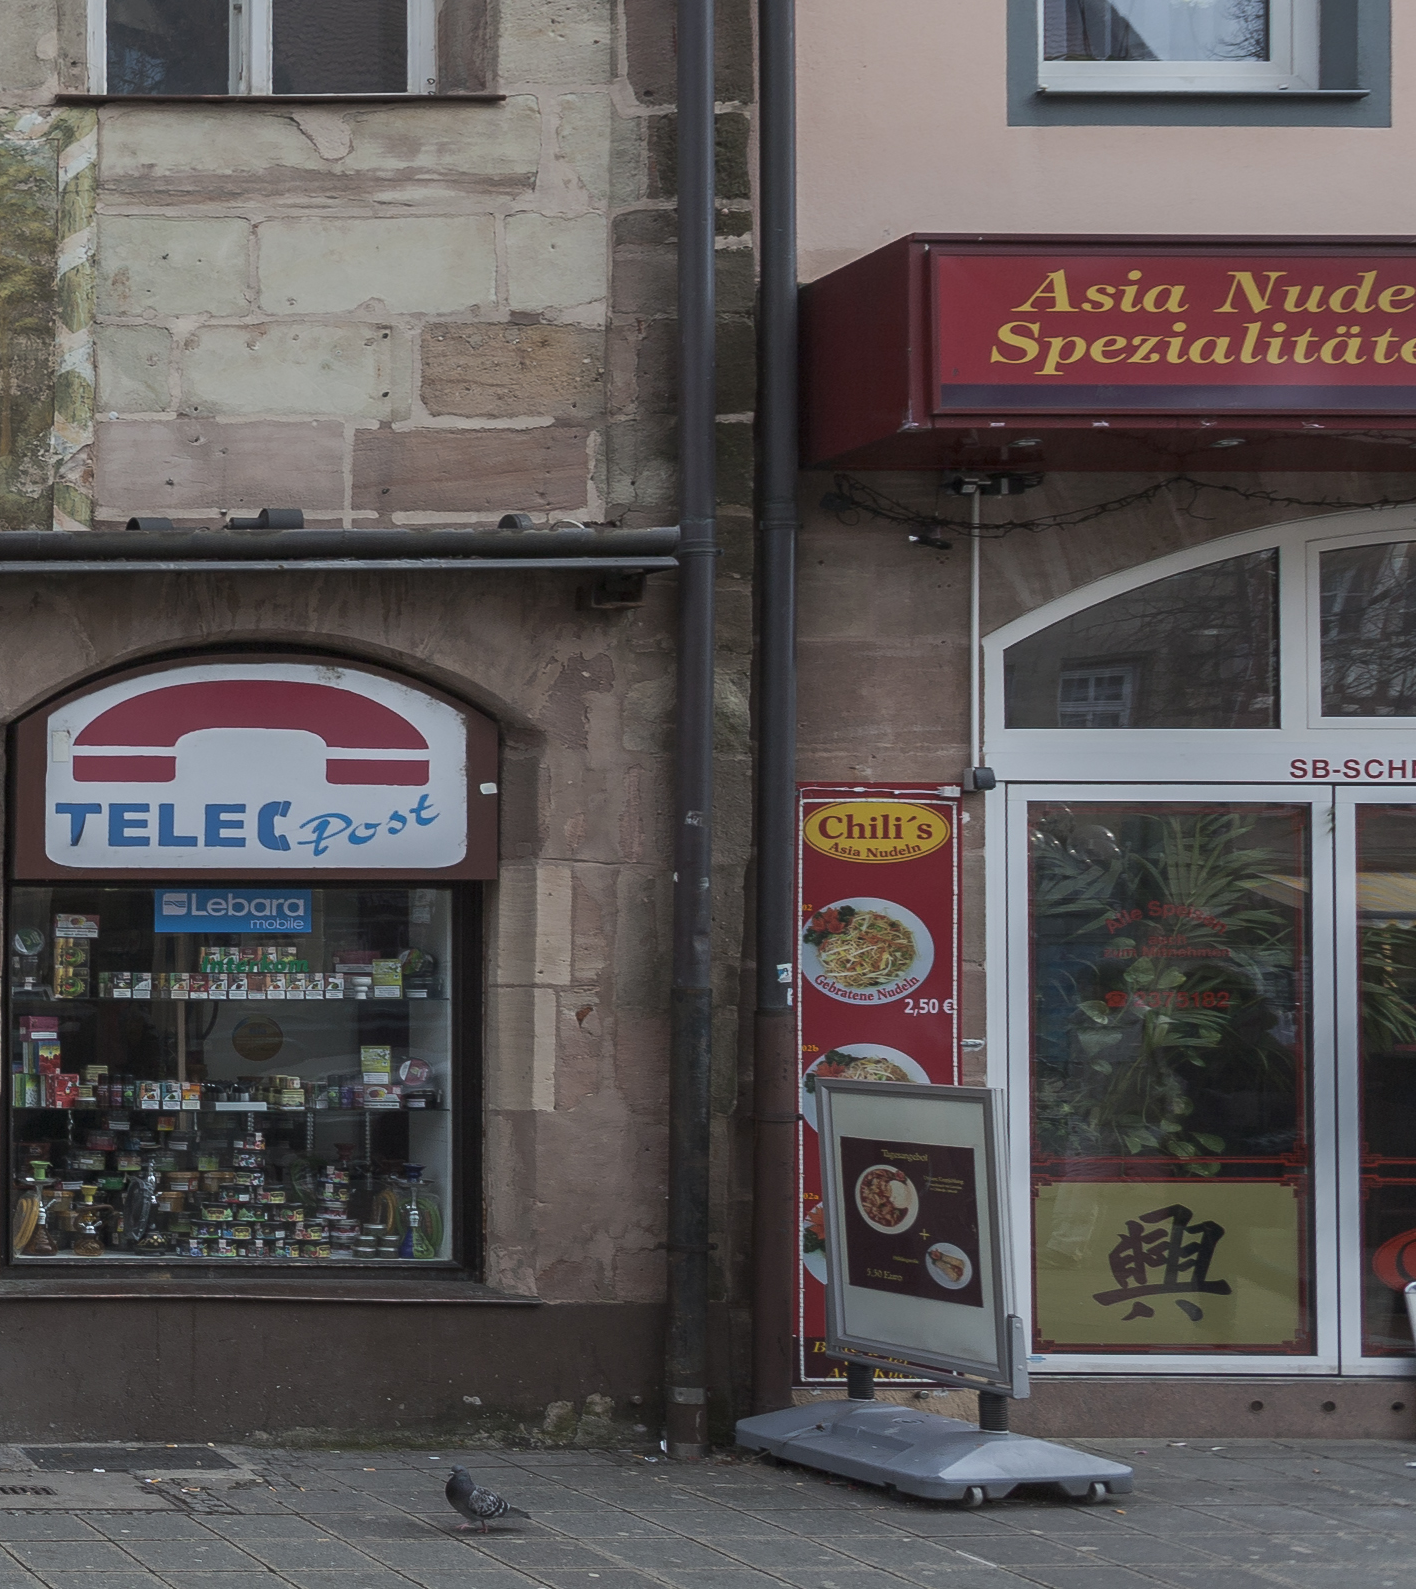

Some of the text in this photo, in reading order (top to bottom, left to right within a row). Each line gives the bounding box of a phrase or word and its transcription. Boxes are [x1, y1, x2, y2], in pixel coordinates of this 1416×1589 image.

[1010, 268, 1190, 314] Asia
[1289, 758, 1416, 779] SB-SCH
[296, 793, 441, 857] Post
[828, 842, 922, 858] Asia Nudeln
[191, 893, 305, 917] Lebara
[249, 917, 305, 930] mobile
[1104, 900, 1228, 935] Alle Speisen
[1148, 933, 1187, 945] auch
[1103, 946, 1232, 958] zum Mitnehmen
[201, 954, 310, 974] Interkom
[814, 974, 921, 1002] Gebratene Nudeln
[904, 998, 939, 1016] 2,50
[1132, 991, 1231, 1008] 2375182
